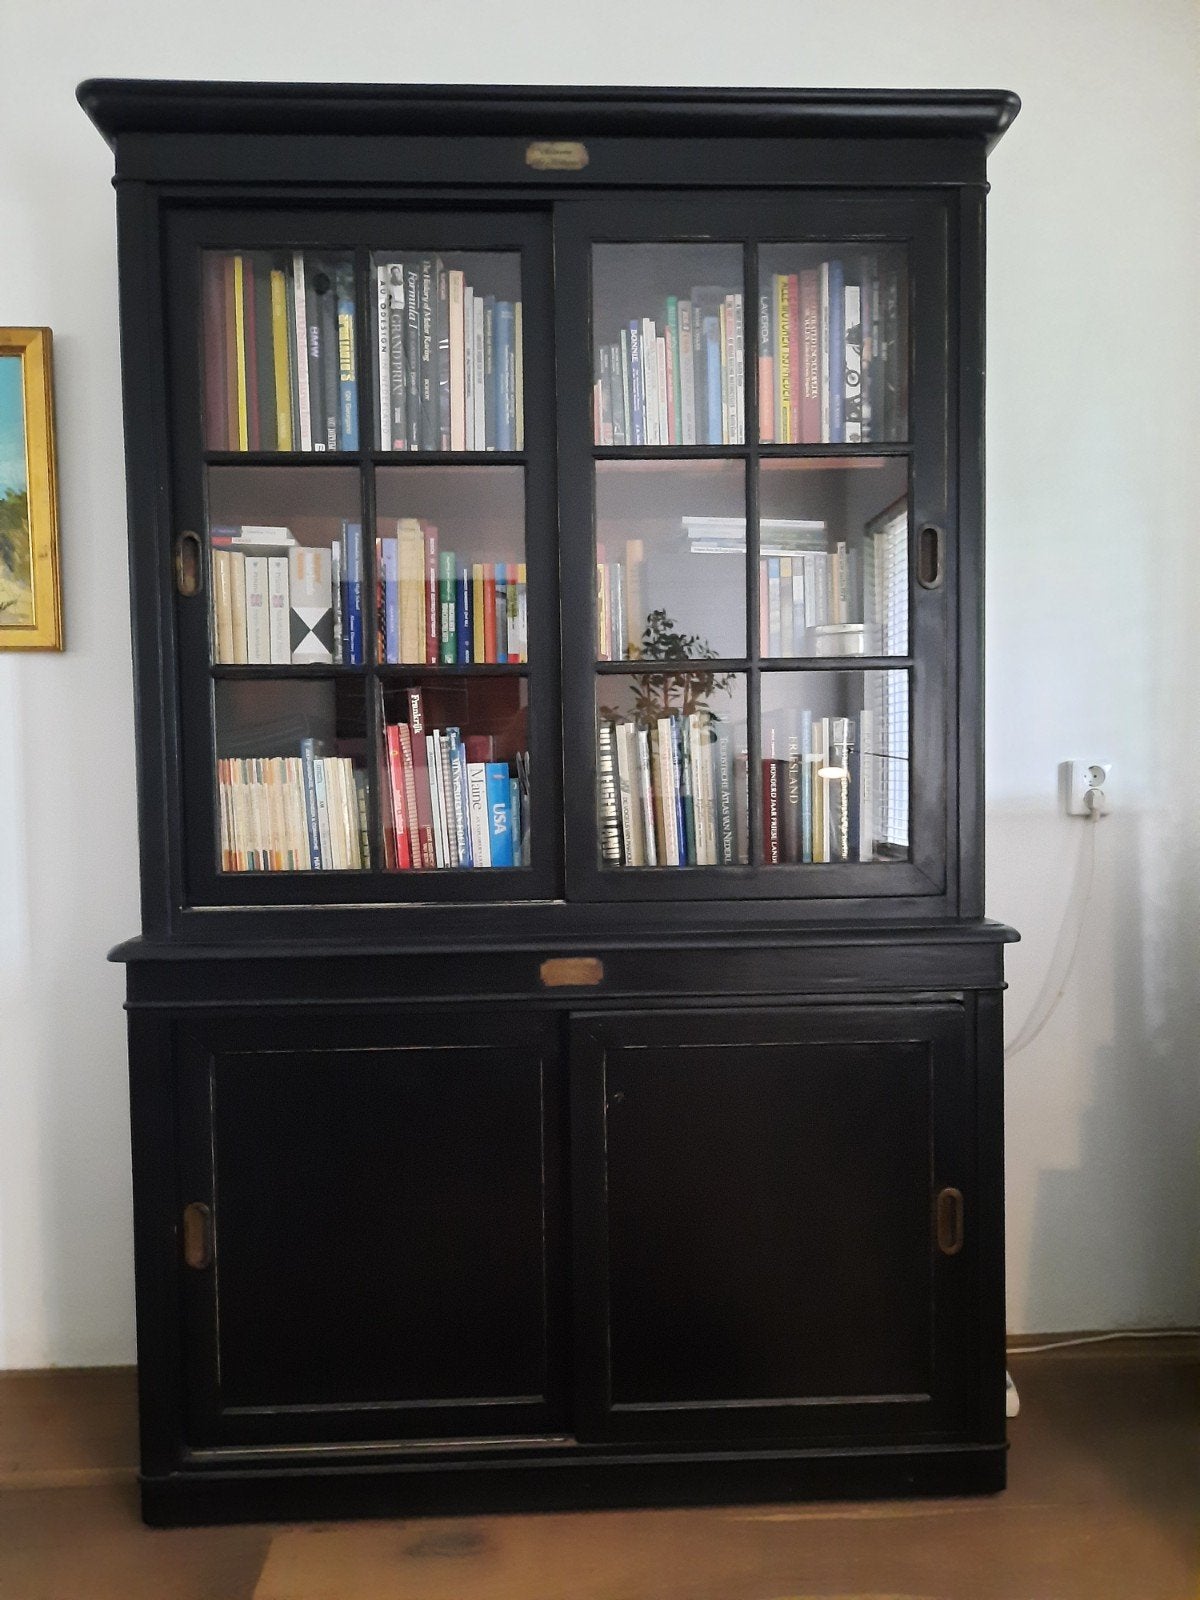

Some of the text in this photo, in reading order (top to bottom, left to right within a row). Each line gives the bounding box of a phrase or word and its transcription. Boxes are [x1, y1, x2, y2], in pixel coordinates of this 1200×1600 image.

[407, 271, 420, 321] Formula
[380, 280, 388, 353] AUODESIGN
[759, 296, 770, 345] LAVERDA
[309, 326, 320, 358] BMW
[391, 314, 402, 360] GRAND
[422, 335, 433, 362] Racing
[630, 329, 640, 363] BONNIE
[410, 694, 423, 734] Frankrijk
[769, 763, 777, 798] HONDERD
[787, 735, 799, 804] FRIESLAND
[470, 768, 485, 810] Maine
[721, 791, 731, 814] ATLAS
[493, 803, 507, 834] USA
[722, 815, 730, 830] VAN
[770, 817, 778, 840] FRIESE
